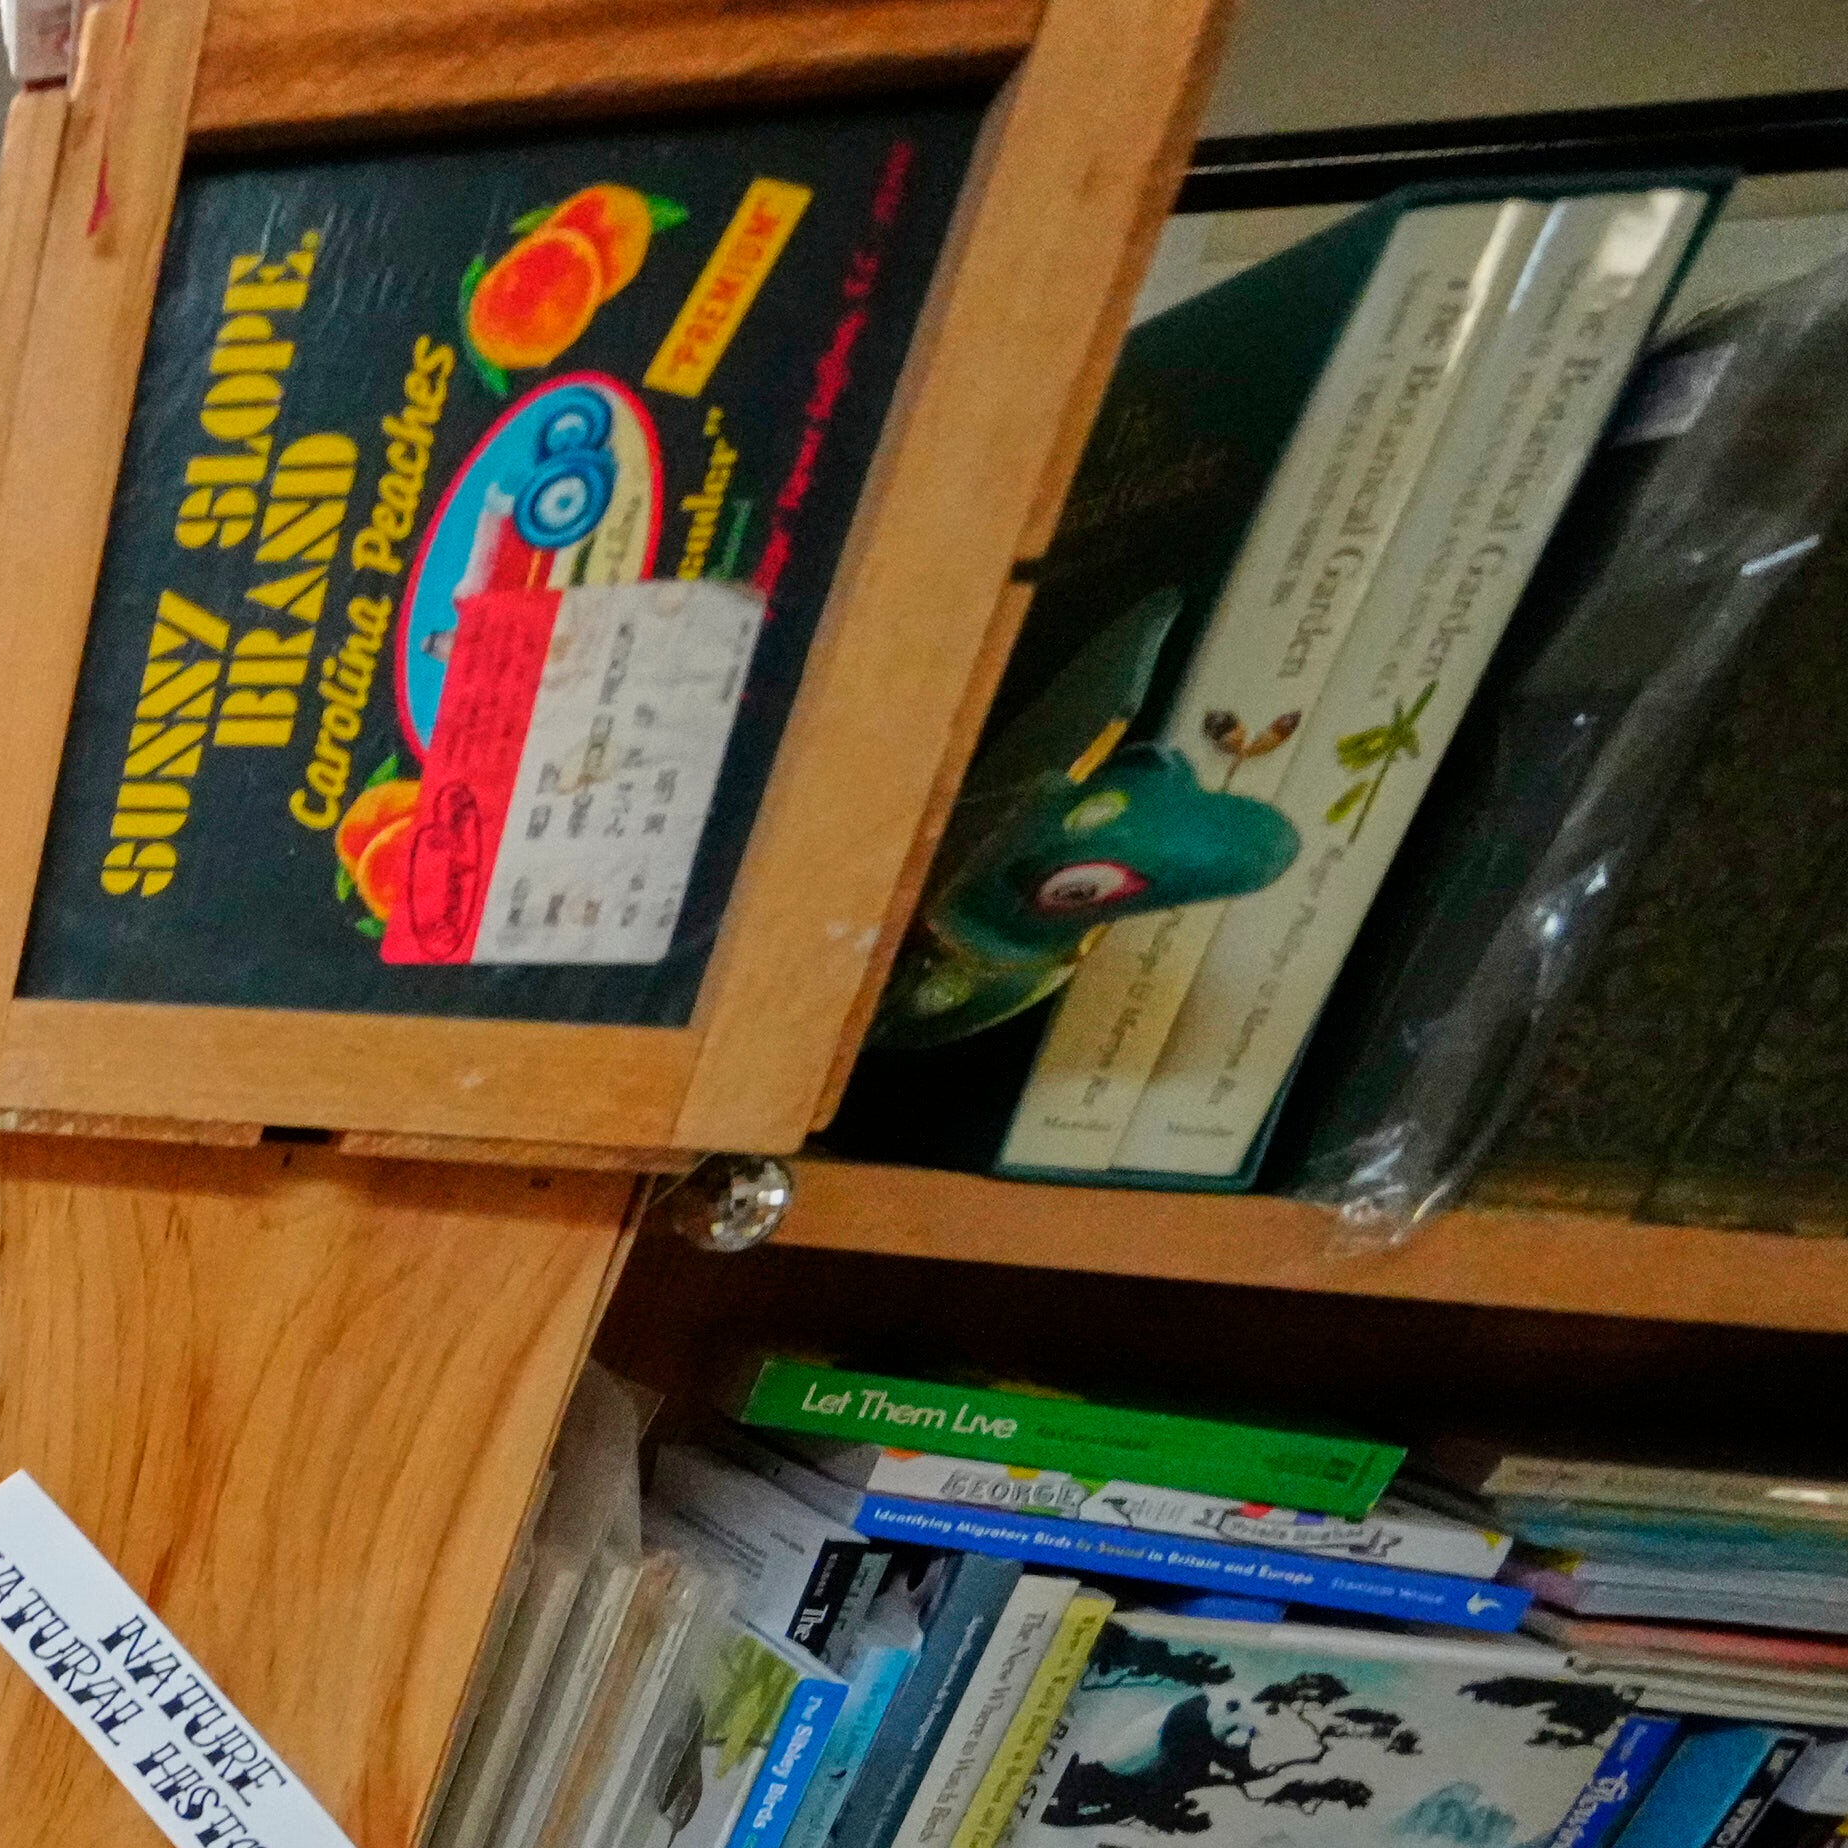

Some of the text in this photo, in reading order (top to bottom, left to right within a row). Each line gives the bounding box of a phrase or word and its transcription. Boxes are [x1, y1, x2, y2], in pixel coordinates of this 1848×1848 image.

[102, 253, 315, 897] SUNNY SLOPE
[215, 433, 358, 746] BRAND
[289, 335, 454, 829] Carolina Peaches
[802, 1382, 1017, 1440] Let Them Live
[874, 1507, 952, 1533] Identifying
[958, 1519, 1028, 1546] Migratory
[1033, 1530, 1073, 1550] Birds
[1223, 1559, 1257, 1577] and
[1258, 1563, 1314, 1586] Europe
[940, 1467, 1090, 1516] GEORGE
[99, 1613, 286, 1807] NATURE
[1010, 1717, 1070, 1820] BEAST
